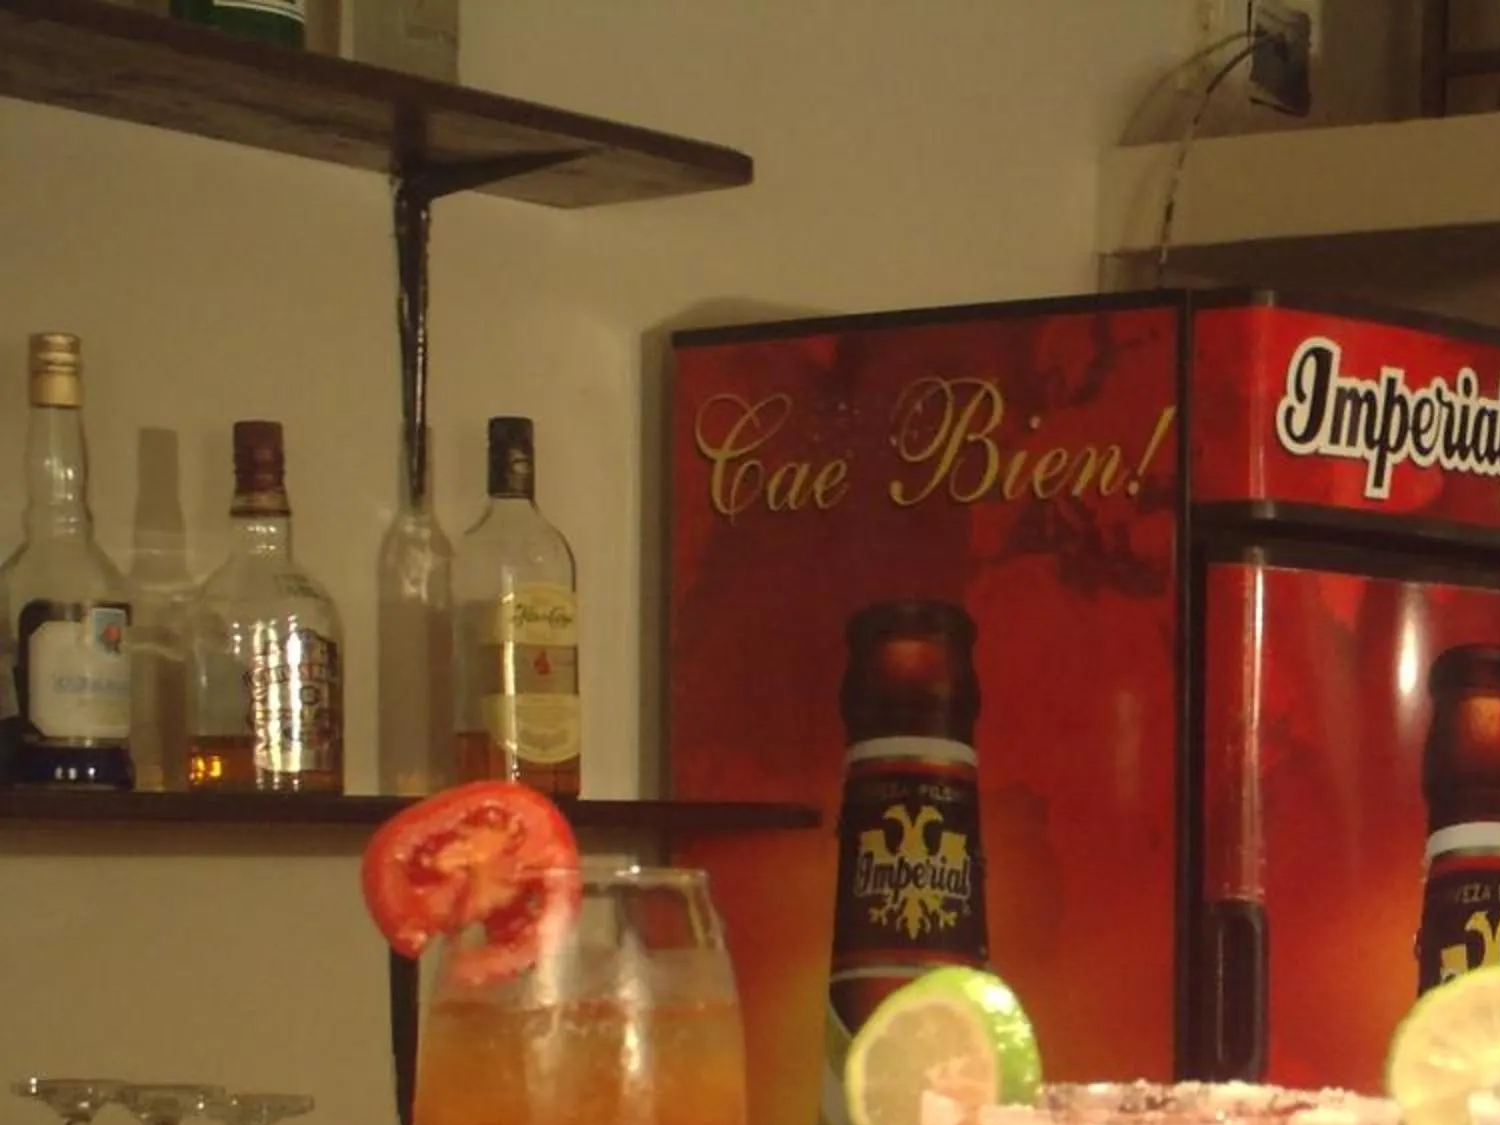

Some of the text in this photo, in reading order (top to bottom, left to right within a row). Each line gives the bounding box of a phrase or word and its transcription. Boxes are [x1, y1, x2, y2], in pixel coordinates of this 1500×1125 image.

[694, 377, 1178, 524] Cae Bien!
[854, 849, 971, 912] Imperial
